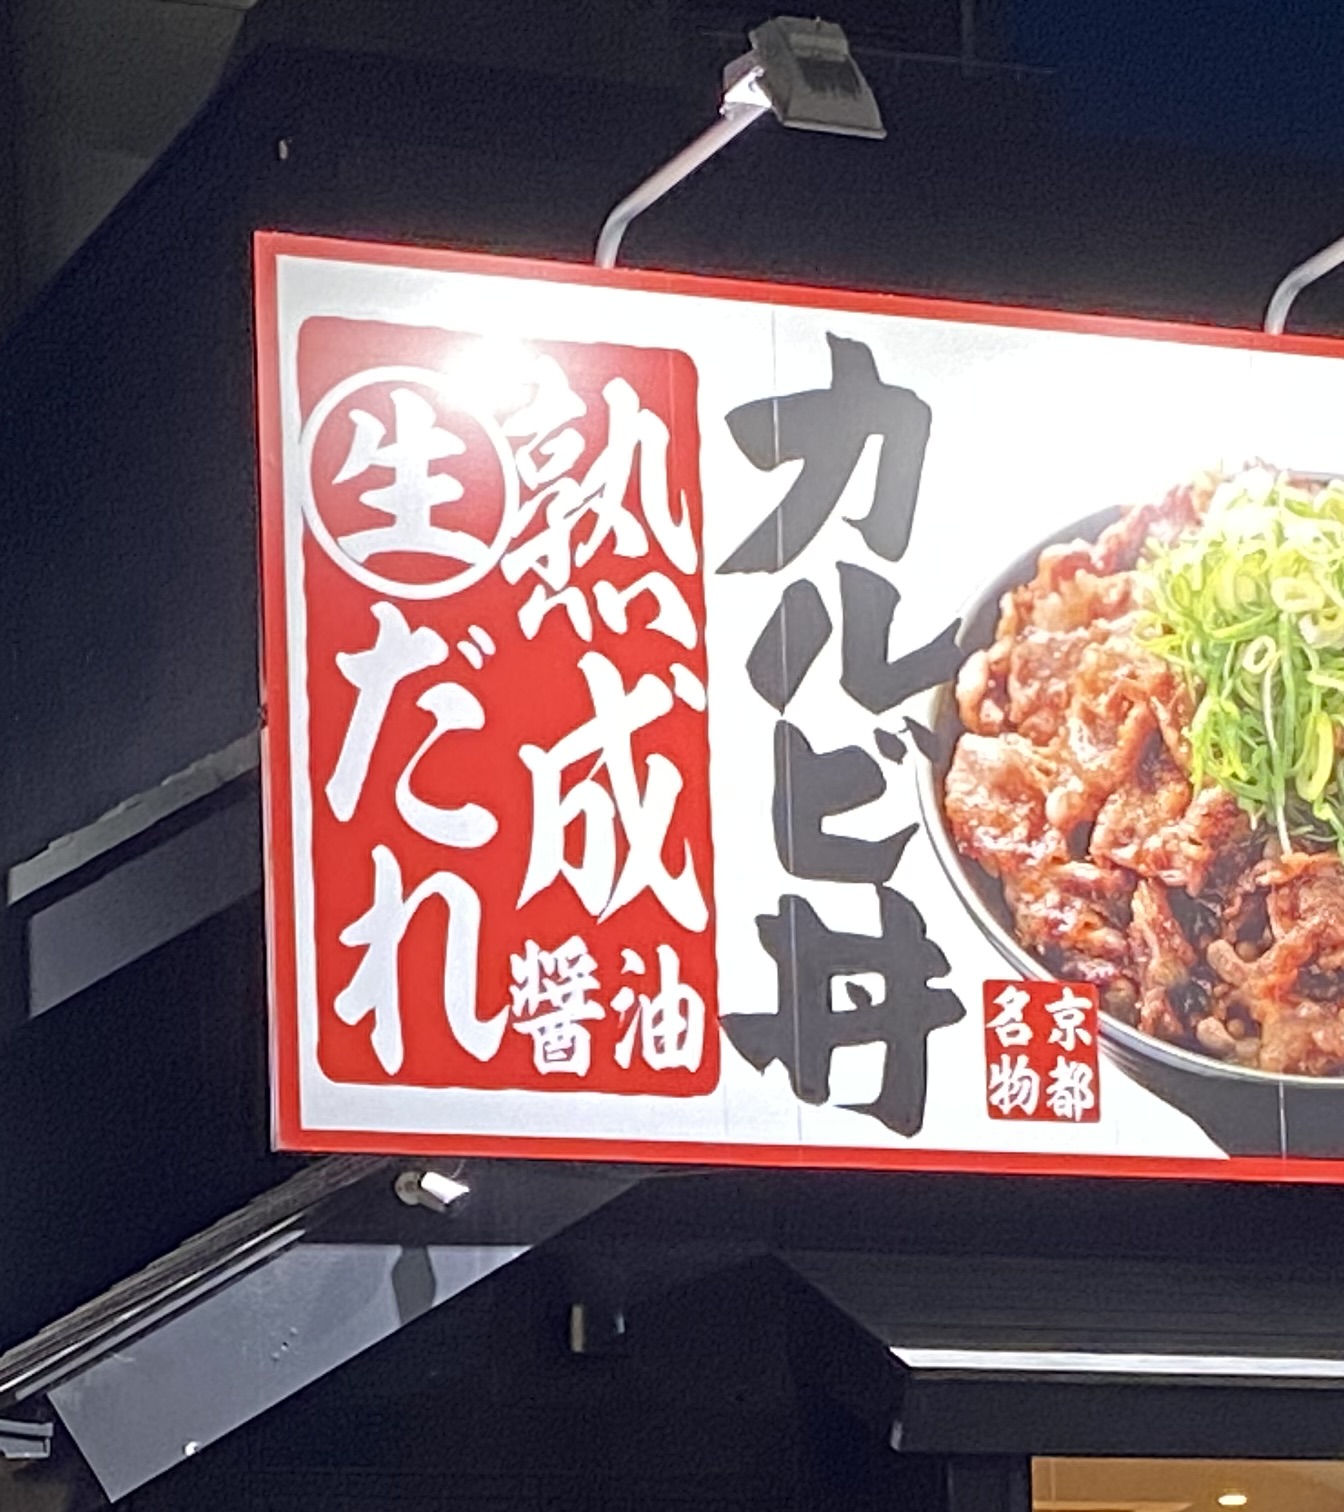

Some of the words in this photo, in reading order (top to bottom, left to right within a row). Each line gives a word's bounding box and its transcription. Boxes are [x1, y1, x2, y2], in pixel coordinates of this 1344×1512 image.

[324, 386, 512, 1076] 生だれ
[512, 350, 711, 930] 熟成
[716, 330, 968, 1136] カルビ丼
[508, 941, 705, 1077] 醤油
